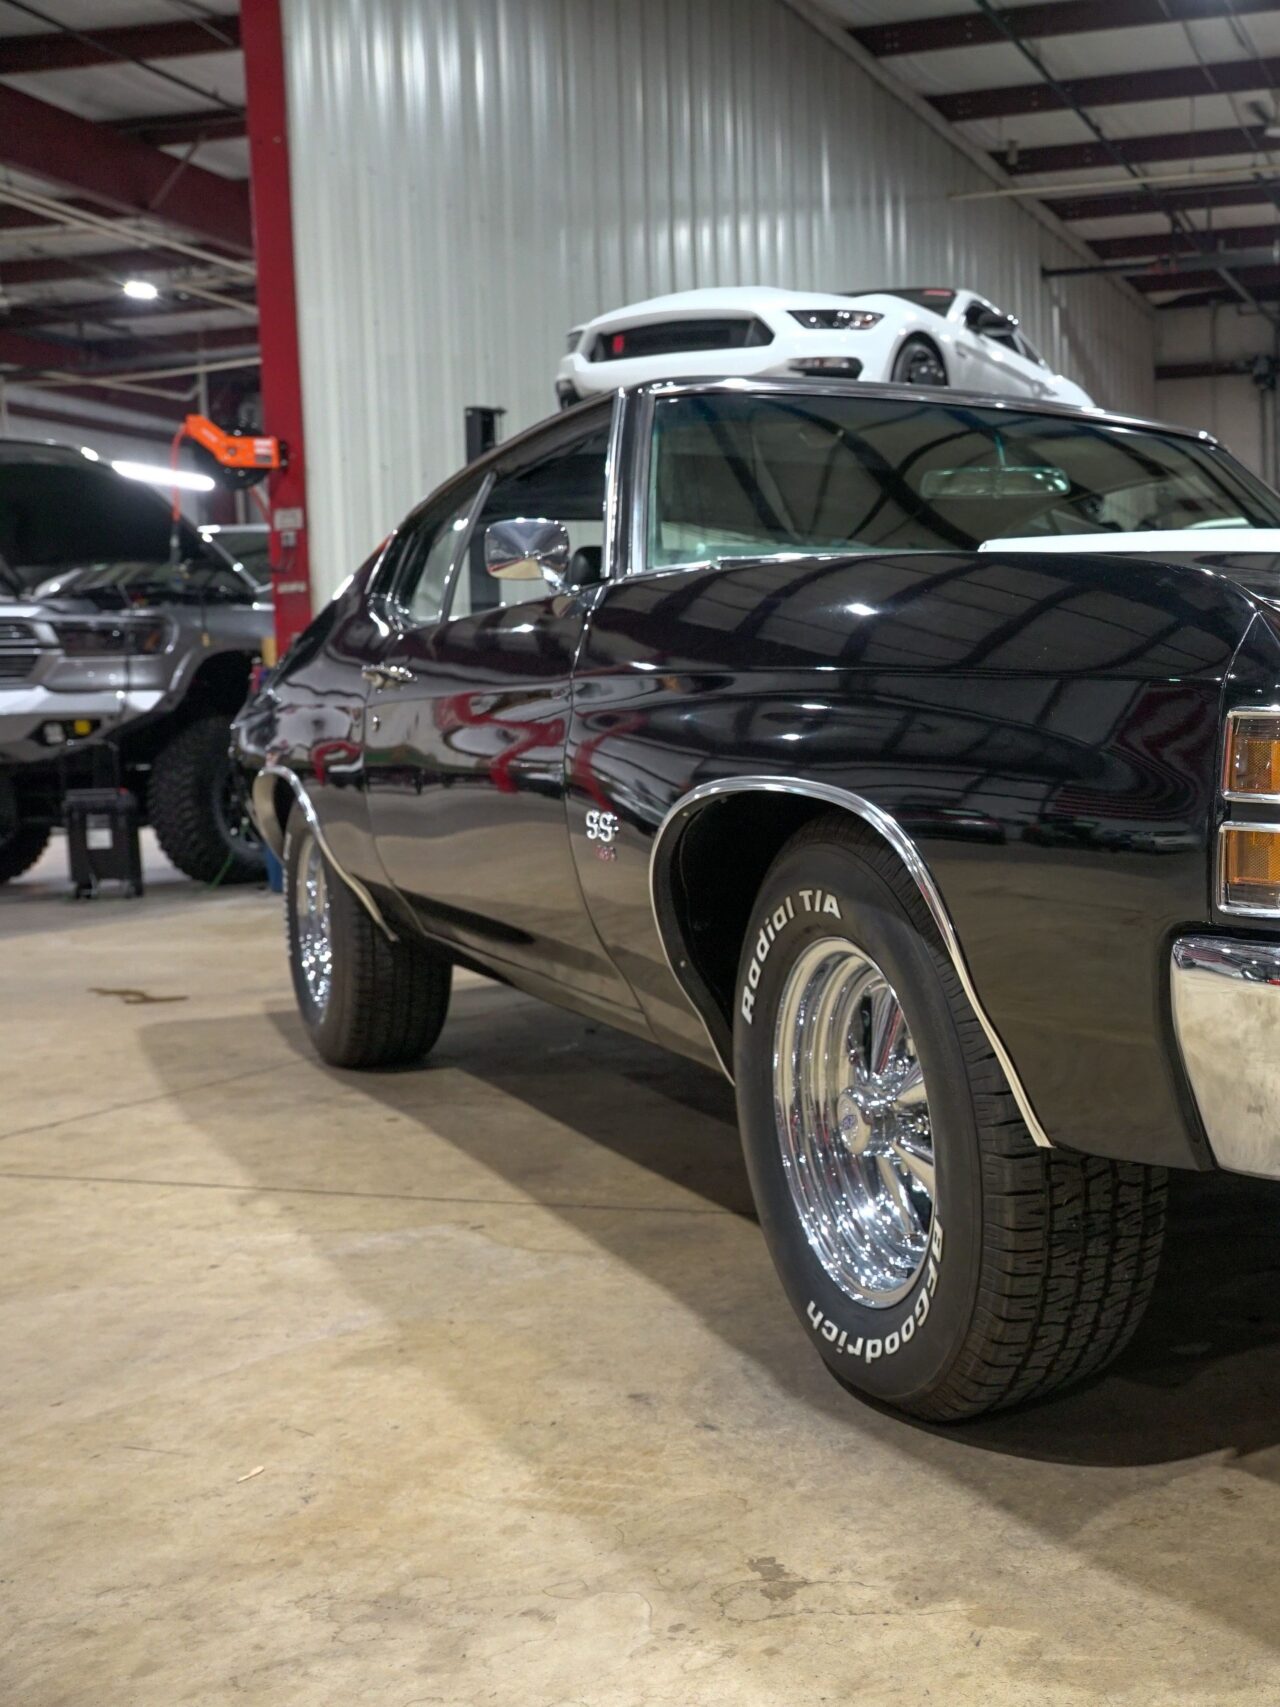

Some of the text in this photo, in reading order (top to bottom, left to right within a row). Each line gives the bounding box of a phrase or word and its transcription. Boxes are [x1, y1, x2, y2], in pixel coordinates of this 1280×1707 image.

[741, 889, 842, 1025] Radial T/A
[806, 1217, 944, 1364] BFGoodrich
